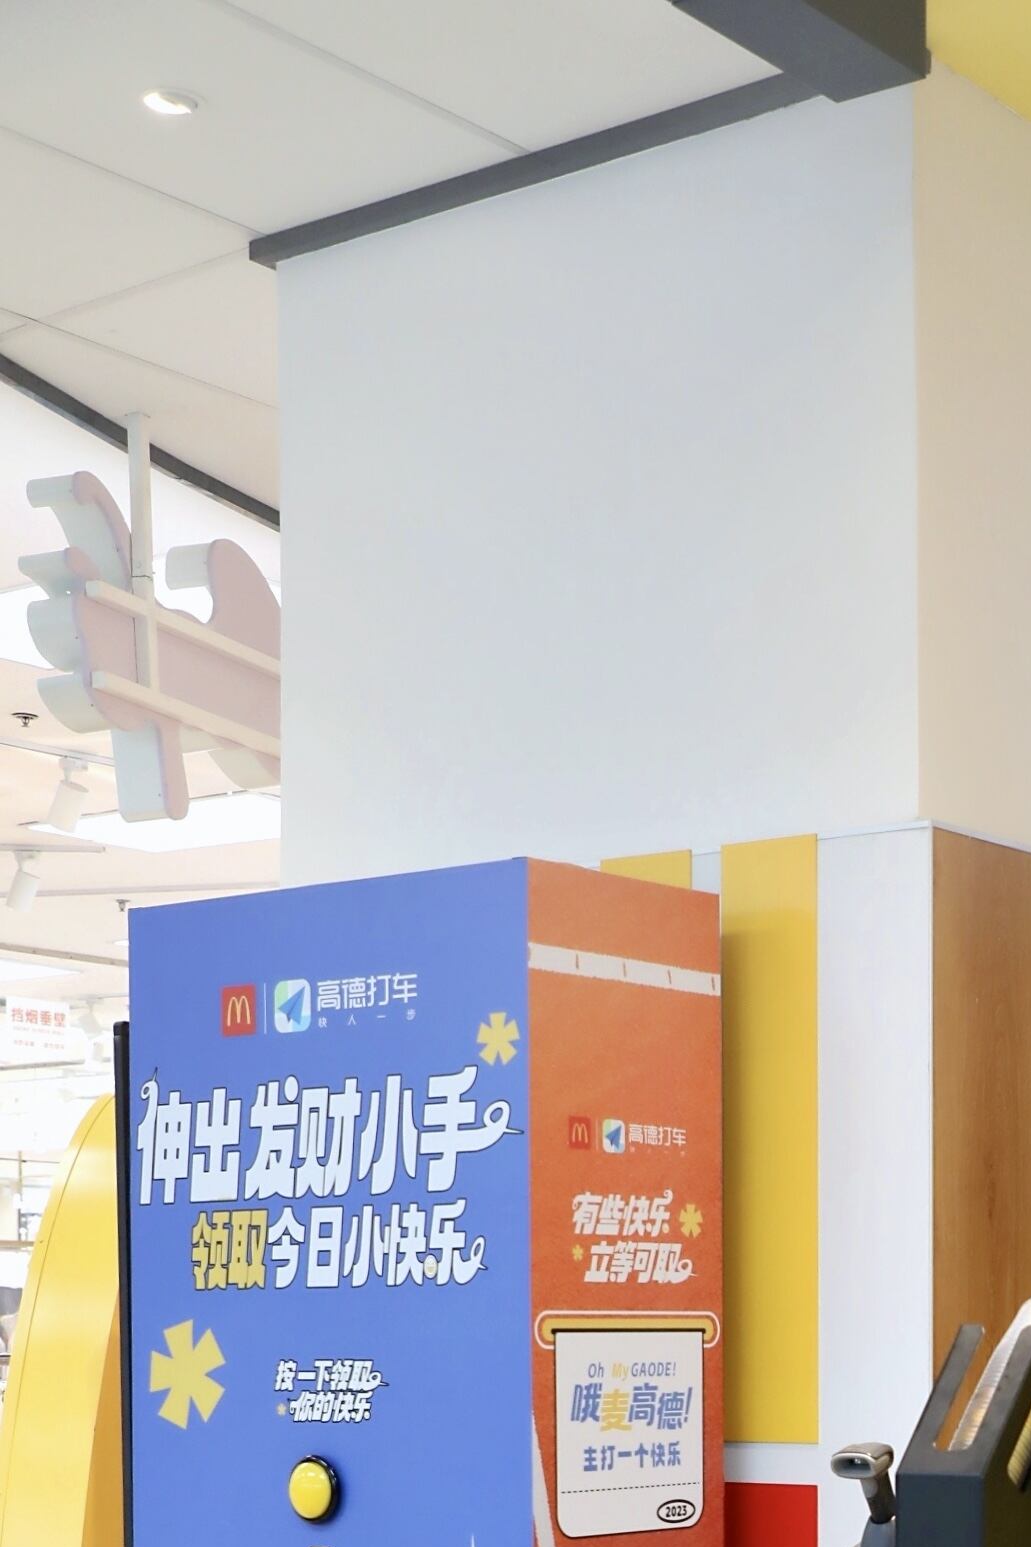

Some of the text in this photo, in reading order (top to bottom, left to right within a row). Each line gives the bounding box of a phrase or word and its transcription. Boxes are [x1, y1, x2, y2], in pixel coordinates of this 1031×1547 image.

[317, 972, 418, 1011] 高德打车
[136, 1065, 524, 1205] 伸出发财小手
[628, 1123, 687, 1147] 高德打车
[572, 1189, 674, 1237] 有些快乐
[191, 1198, 488, 1290] 领取今日小快乐
[584, 1241, 698, 1283] 立等可取
[274, 1359, 389, 1391] 按一下领取
[588, 1361, 676, 1381] Oh My GAODE!
[288, 1390, 374, 1423] 你的快乐
[583, 1441, 681, 1472] 主打一个快乐
[665, 1505, 687, 1517] 2023
